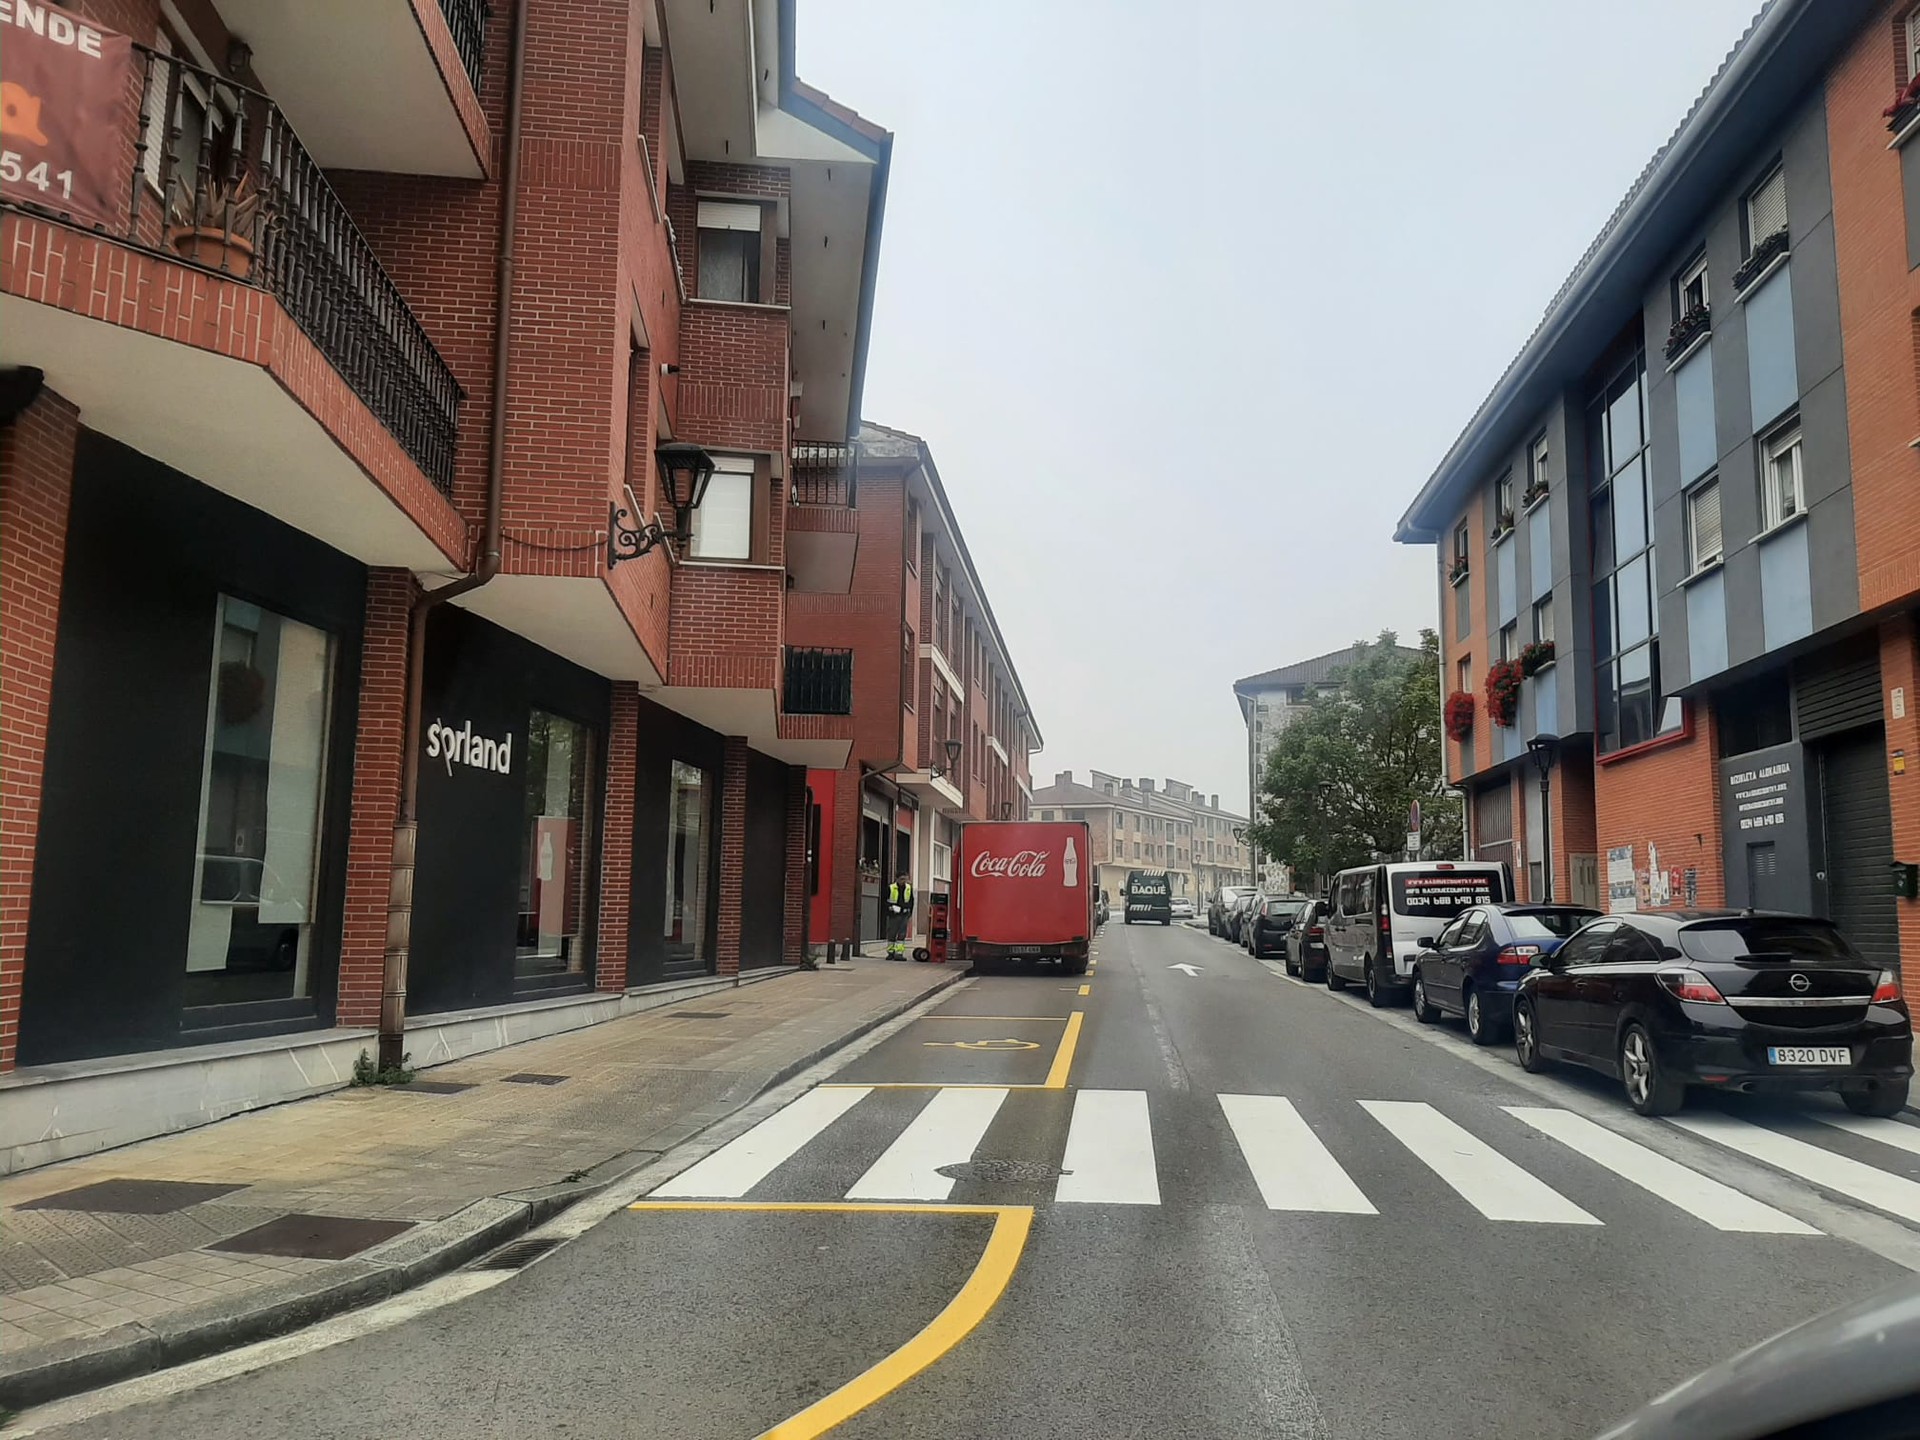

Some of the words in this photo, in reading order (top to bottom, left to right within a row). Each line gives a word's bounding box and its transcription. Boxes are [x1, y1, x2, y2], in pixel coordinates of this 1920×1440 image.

[0, 150, 72, 200] 541
[1778, 1049, 1815, 1062] 8320
[1819, 1049, 1846, 1062] DVF
